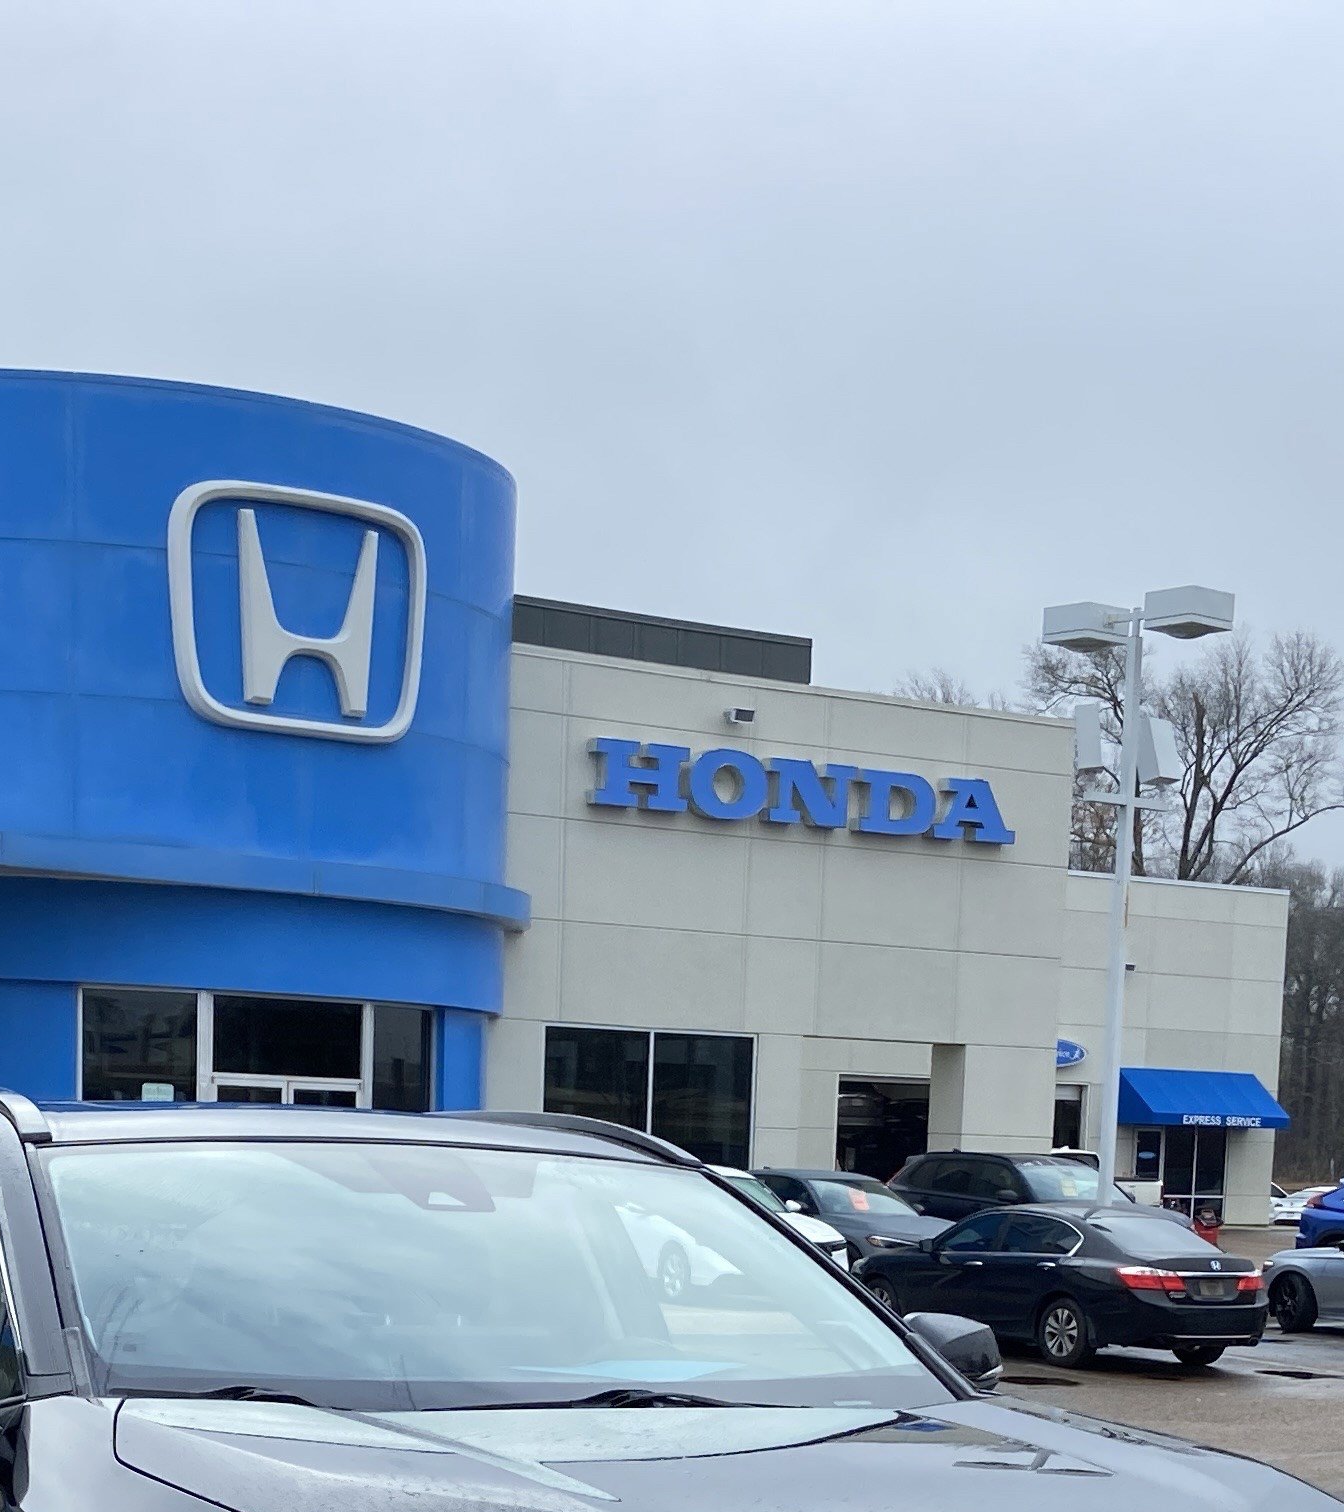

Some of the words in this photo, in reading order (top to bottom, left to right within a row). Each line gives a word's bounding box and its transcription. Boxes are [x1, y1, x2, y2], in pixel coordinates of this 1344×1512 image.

[587, 736, 1016, 845] HONDA
[1182, 1114, 1222, 1126] EXPRESS
[1225, 1116, 1262, 1127] SERVICE
